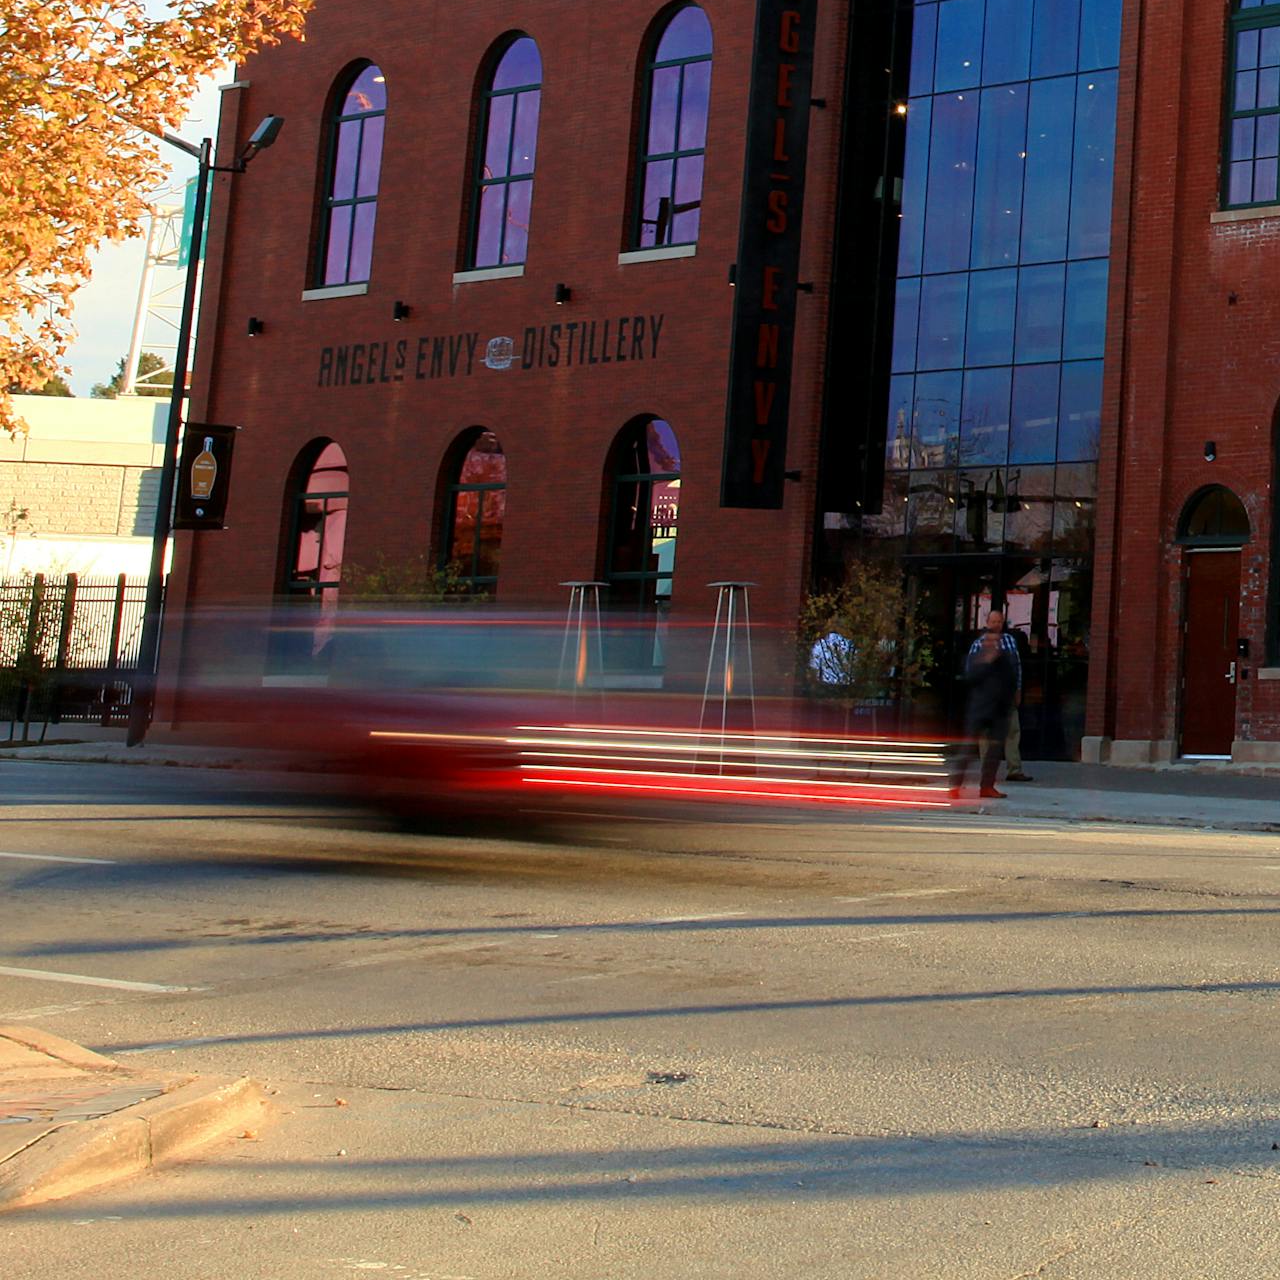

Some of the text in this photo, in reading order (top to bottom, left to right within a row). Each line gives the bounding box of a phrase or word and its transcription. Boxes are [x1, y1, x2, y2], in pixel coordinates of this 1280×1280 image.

[415, 332, 479, 380] ENVY
[522, 314, 664, 369] DISTILLERY
[751, 266, 781, 483] ENVY
